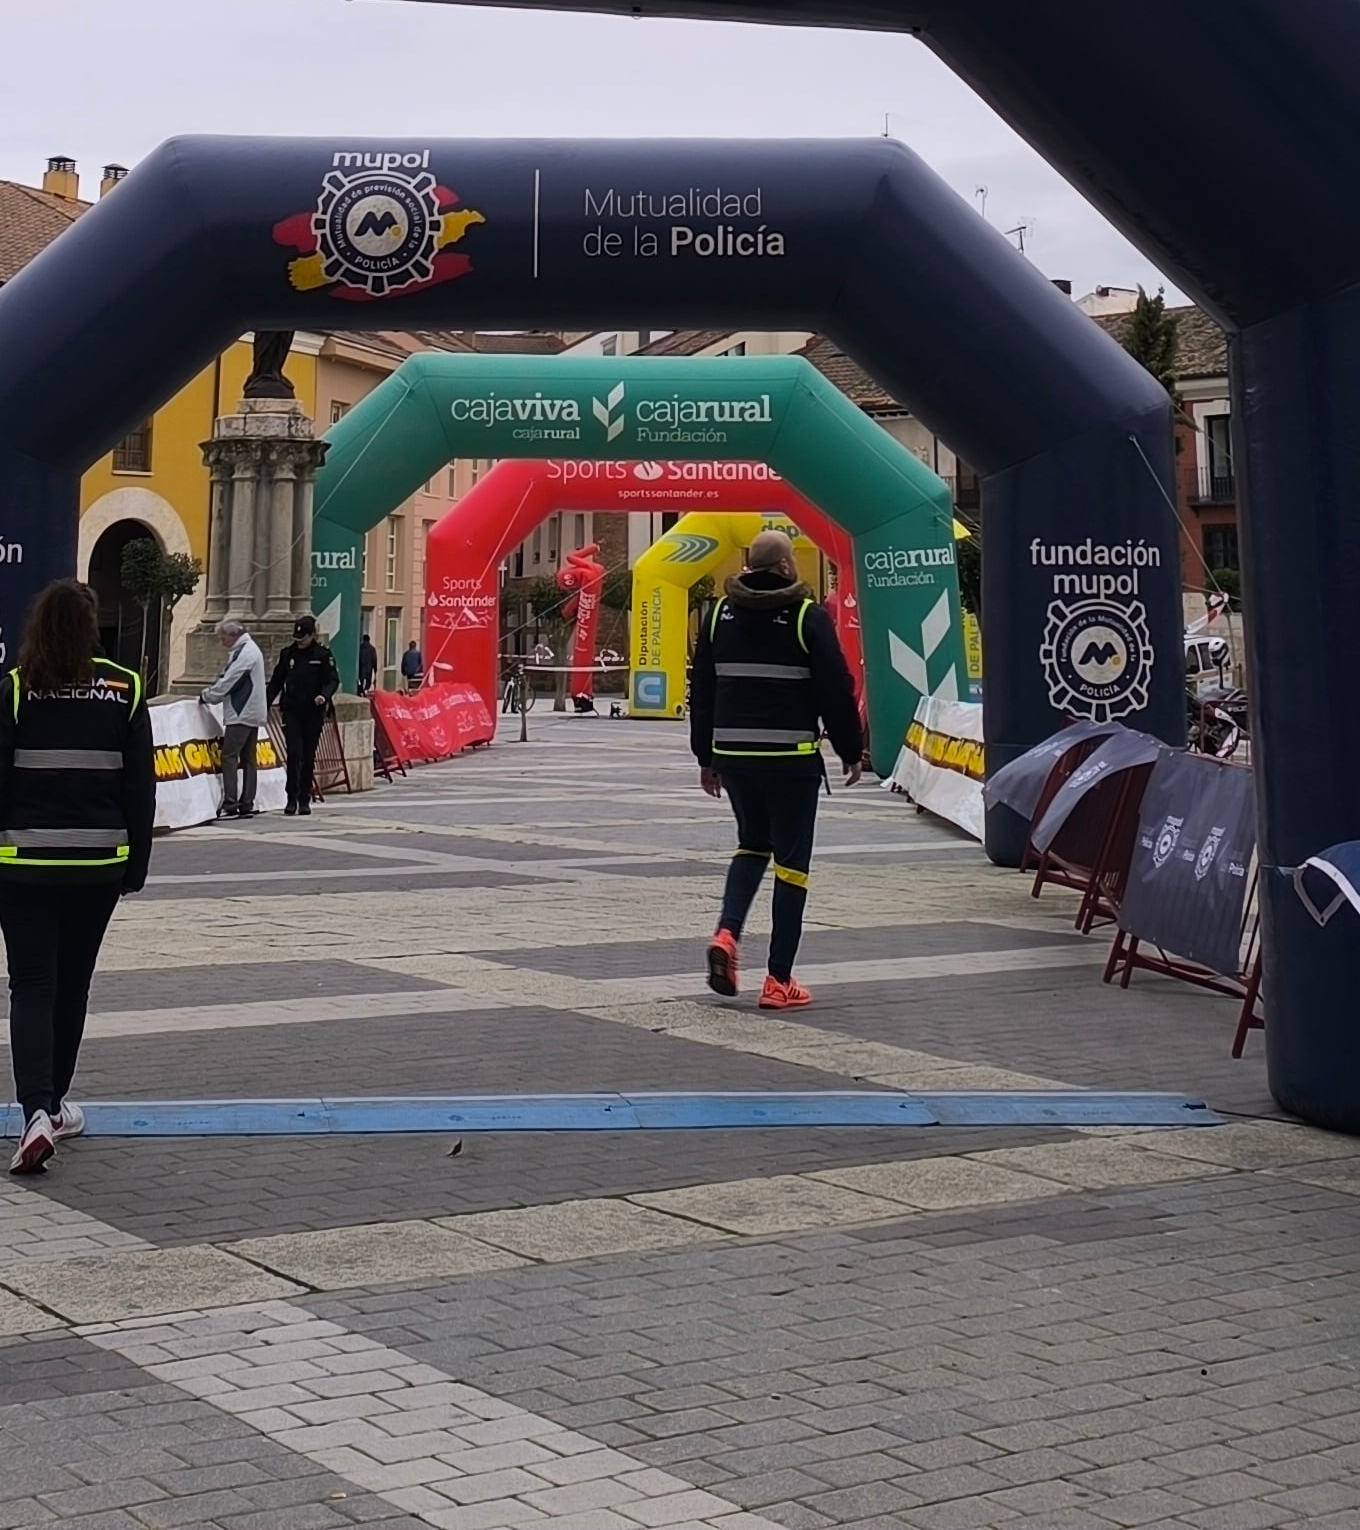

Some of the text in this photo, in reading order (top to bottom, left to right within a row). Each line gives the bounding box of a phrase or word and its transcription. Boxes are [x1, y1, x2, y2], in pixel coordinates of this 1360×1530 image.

[332, 150, 430, 171] mupol
[584, 187, 762, 217] Mutualidad
[583, 226, 785, 257] de la Policía
[451, 392, 772, 429] cajaviva cajarural
[512, 426, 727, 443] cajarural Fundación
[667, 461, 783, 482] Santande
[618, 489, 719, 500] sportssantander.es
[865, 543, 955, 574] cajarural
[1030, 537, 1160, 566] fundación
[443, 577, 482, 590] Sports
[868, 571, 935, 587] Fundación
[1053, 568, 1138, 599] mupol
[440, 594, 496, 607] Santander
[639, 601, 648, 666] Diputación
[652, 587, 663, 666] DE PALENCIA
[27, 688, 128, 704] NACIONAL
